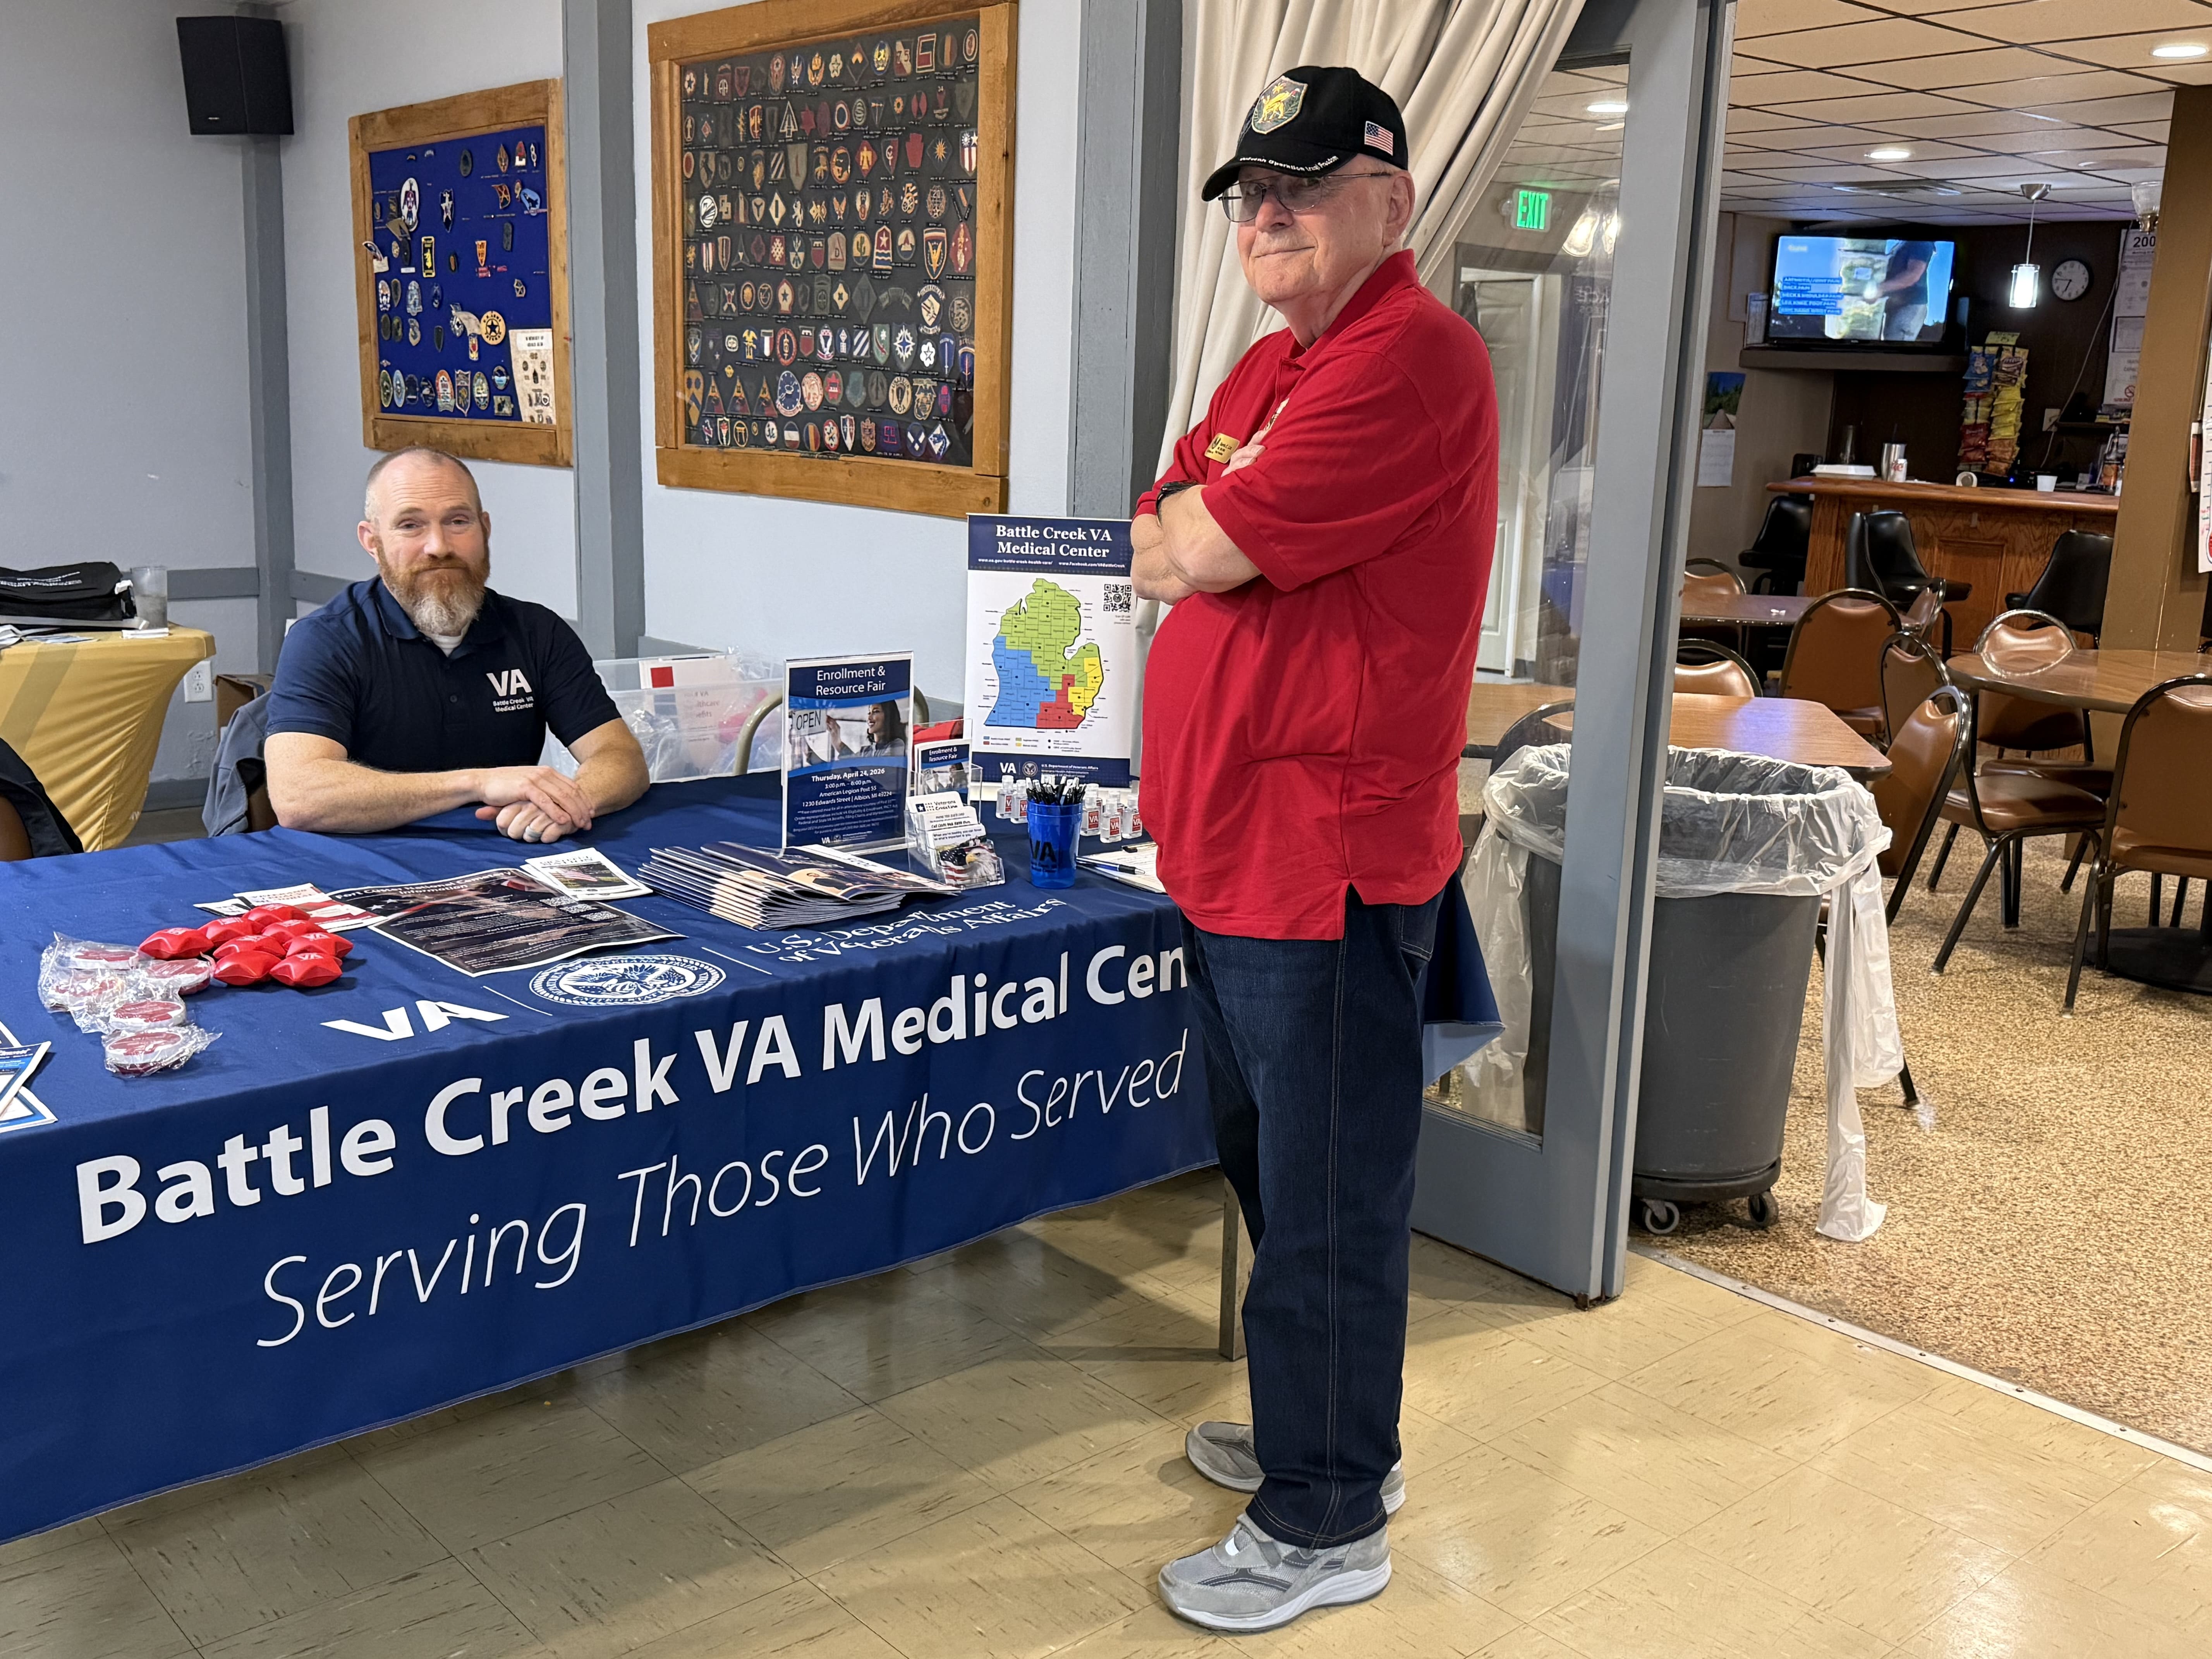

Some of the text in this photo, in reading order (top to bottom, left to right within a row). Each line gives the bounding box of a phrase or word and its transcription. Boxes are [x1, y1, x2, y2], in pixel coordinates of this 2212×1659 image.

[1516, 191, 1548, 230] EXIT
[2133, 236, 2156, 248] 200
[996, 525, 1112, 541] Battle Creek VA
[997, 542, 1109, 557] Medical Center
[817, 666, 886, 681] Enrollment &
[486, 669, 532, 697] VA
[816, 681, 886, 696] Resource Fair
[796, 710, 821, 730] OPEN
[929, 747, 953, 756] Enrollment
[812, 774, 842, 782] Thursday,
[843, 772, 859, 780] April
[1000, 762, 1016, 774] VA
[1029, 838, 1057, 862] VA
[337, 890, 363, 899] Fort
[404, 880, 455, 891] National
[455, 871, 512, 885] Cemetery
[399, 884, 468, 895] Information
[743, 900, 1016, 954] U.S. Department
[778, 898, 1067, 963] of Veterans Affairs
[301, 933, 330, 941] VA
[320, 1000, 509, 1041] VA
[77, 1106, 396, 1244] Battle
[425, 1038, 680, 1155] Creek
[694, 1015, 801, 1093] VA
[823, 951, 1068, 1070] Medical
[257, 1028, 1188, 1346] Serving Those Who Served
